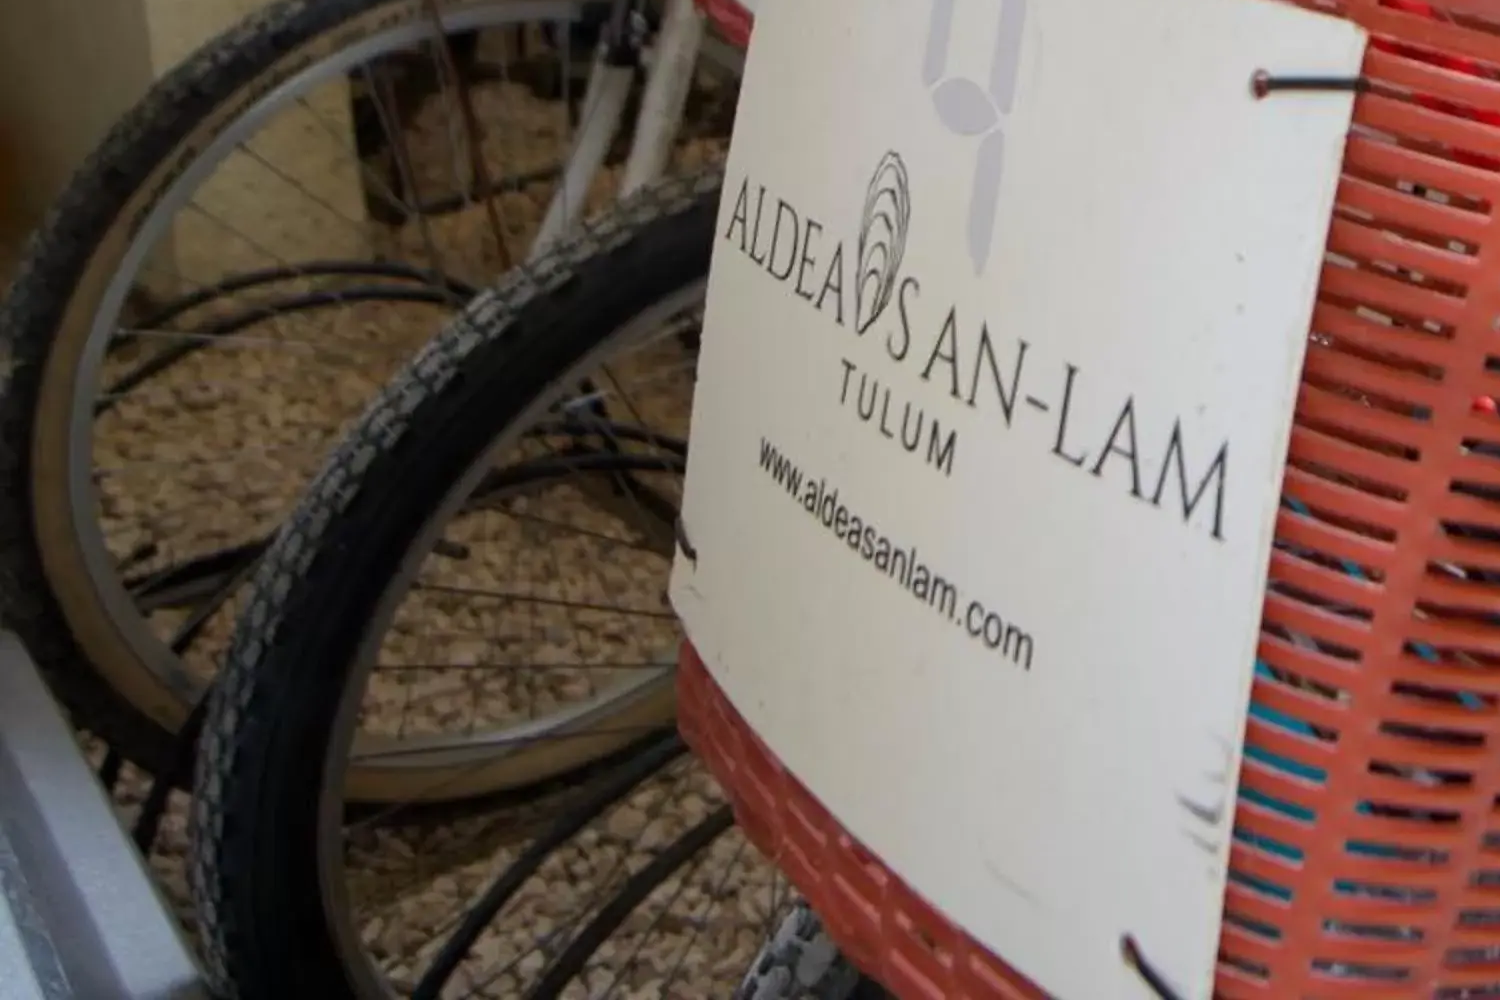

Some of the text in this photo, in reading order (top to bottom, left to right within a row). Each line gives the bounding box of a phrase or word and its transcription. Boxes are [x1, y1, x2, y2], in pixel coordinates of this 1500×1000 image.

[723, 174, 846, 327] ALDEA
[840, 356, 957, 477] TULUM
[758, 436, 1035, 672] www.aldeasanlam.com
